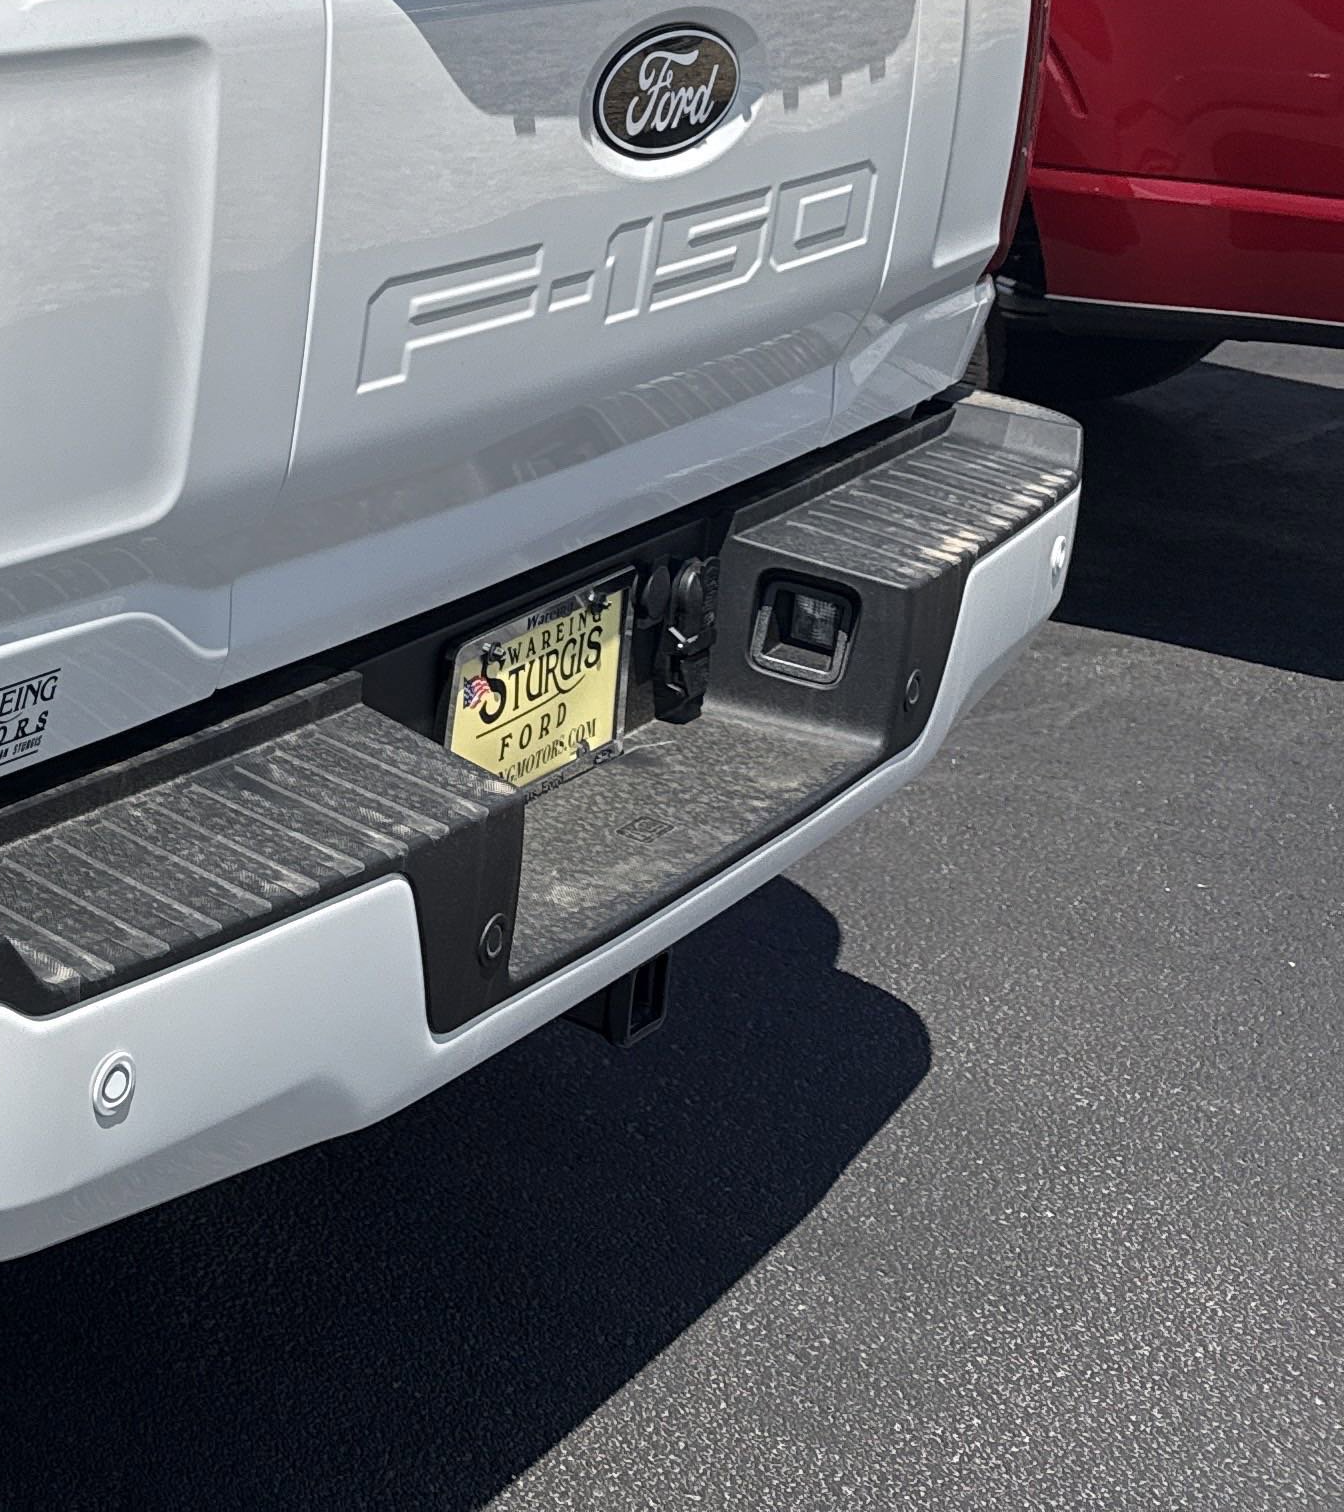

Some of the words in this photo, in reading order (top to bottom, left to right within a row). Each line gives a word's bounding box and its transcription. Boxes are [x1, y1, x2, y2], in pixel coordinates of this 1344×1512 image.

[626, 49, 719, 136] Ford
[357, 159, 877, 394] F-150
[479, 625, 603, 724] STURGIS
[13, 735, 43, 756] STURGIS
[498, 701, 567, 762] FORD
